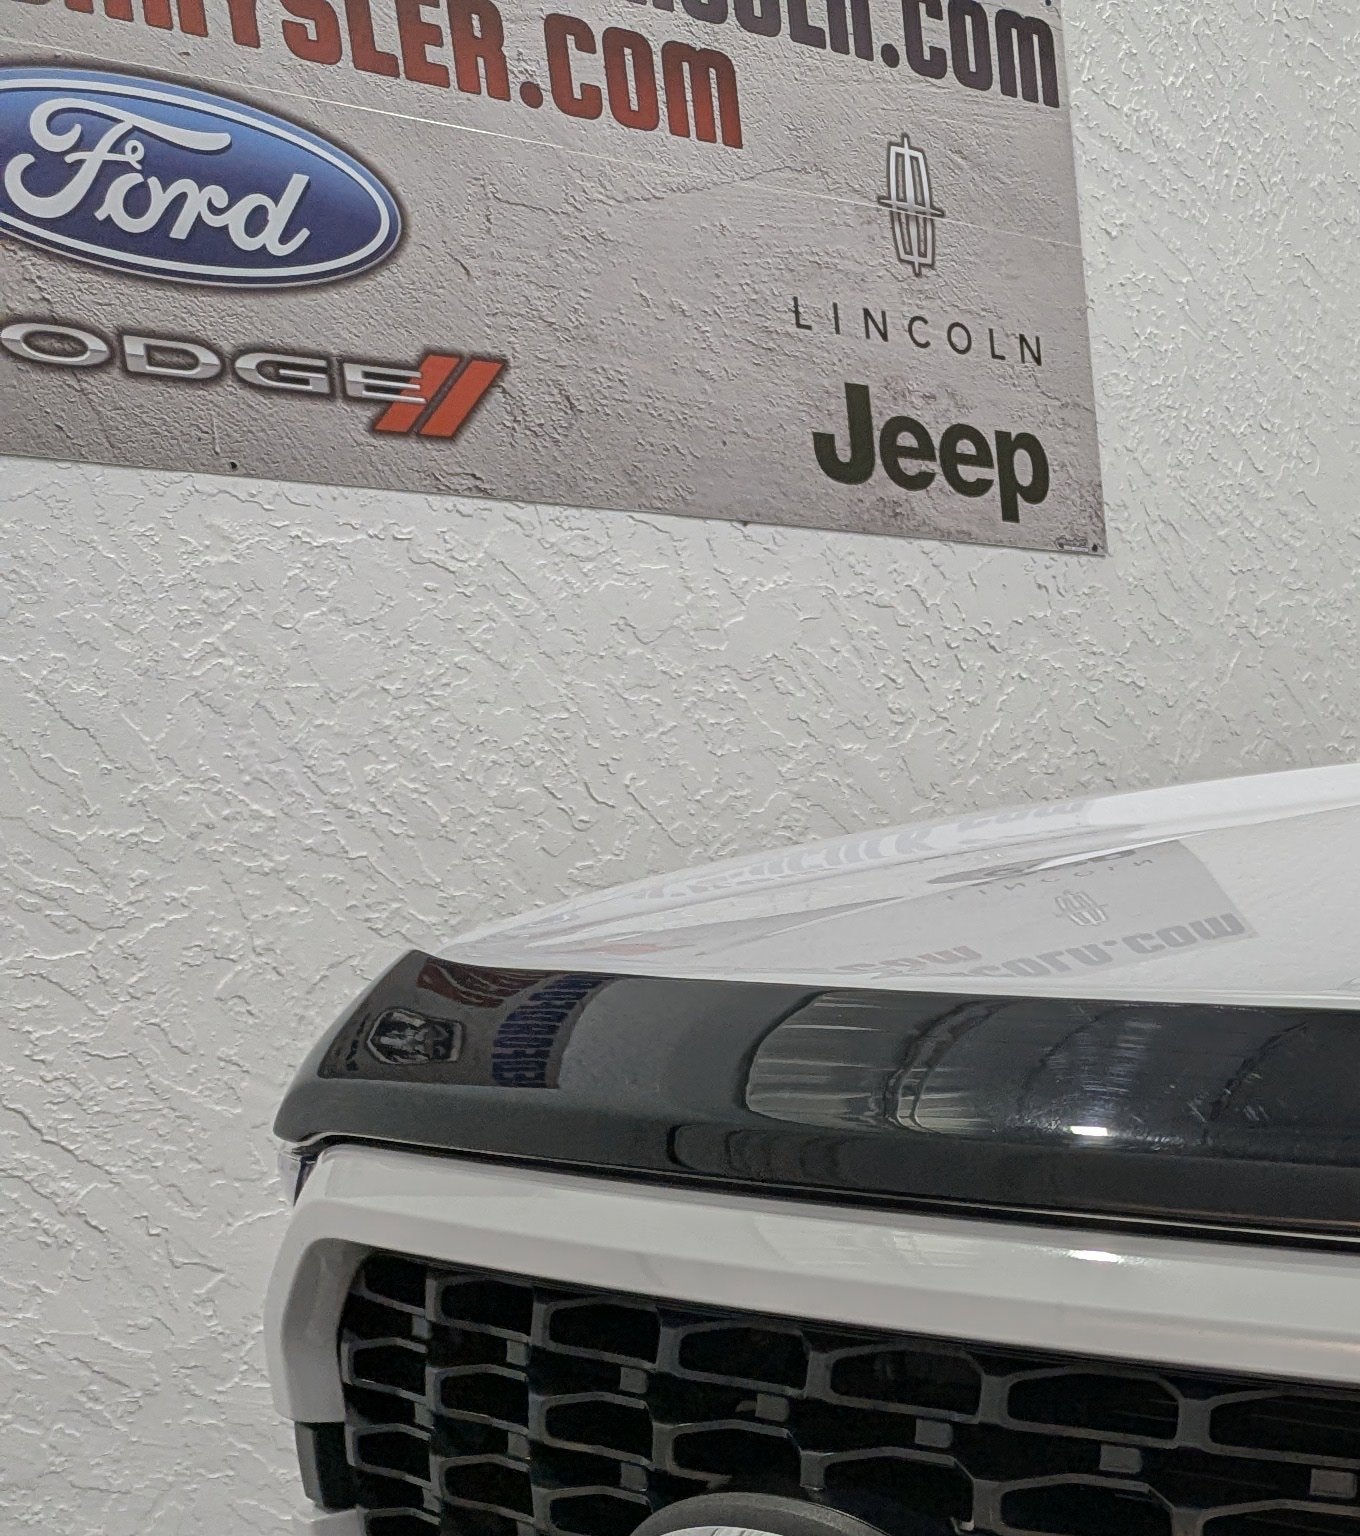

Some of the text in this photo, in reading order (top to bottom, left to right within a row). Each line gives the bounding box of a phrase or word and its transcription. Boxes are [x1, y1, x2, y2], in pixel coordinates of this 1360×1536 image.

[4, 98, 310, 257] Ford
[792, 296, 1043, 367] LINCOLN
[812, 382, 1051, 523] Jeep
